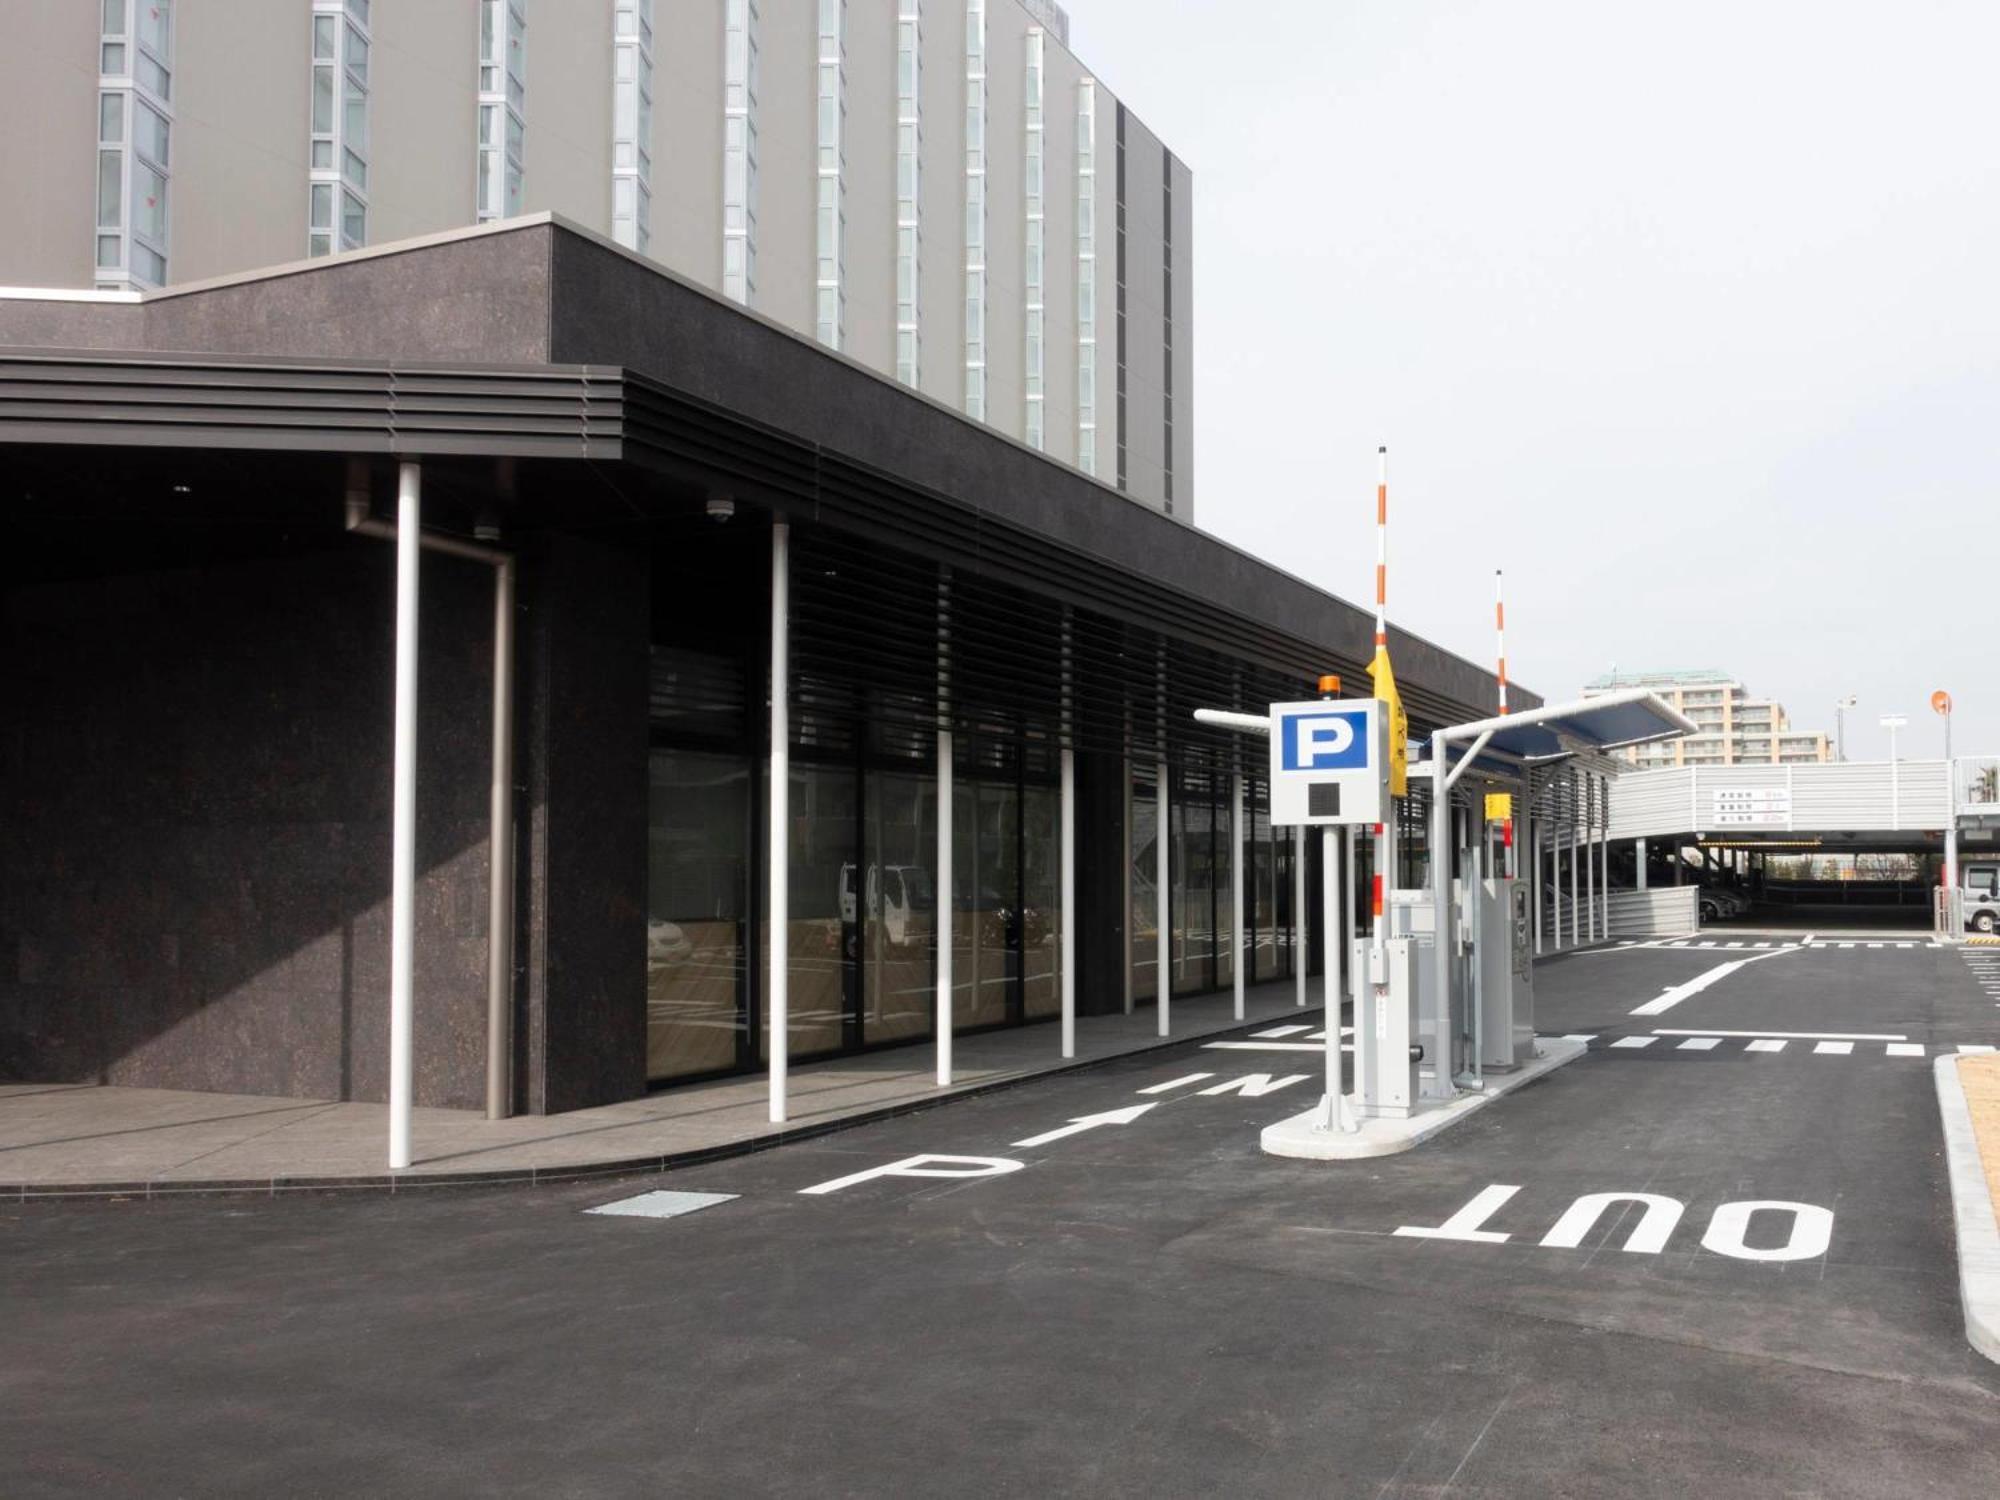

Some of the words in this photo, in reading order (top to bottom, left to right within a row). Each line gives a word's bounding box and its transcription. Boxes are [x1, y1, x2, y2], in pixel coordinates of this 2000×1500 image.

[1297, 717, 1353, 768] P
[1136, 1073, 1312, 1096] IN
[797, 1154, 1026, 1195] P
[1392, 1184, 1834, 1262] OUT
